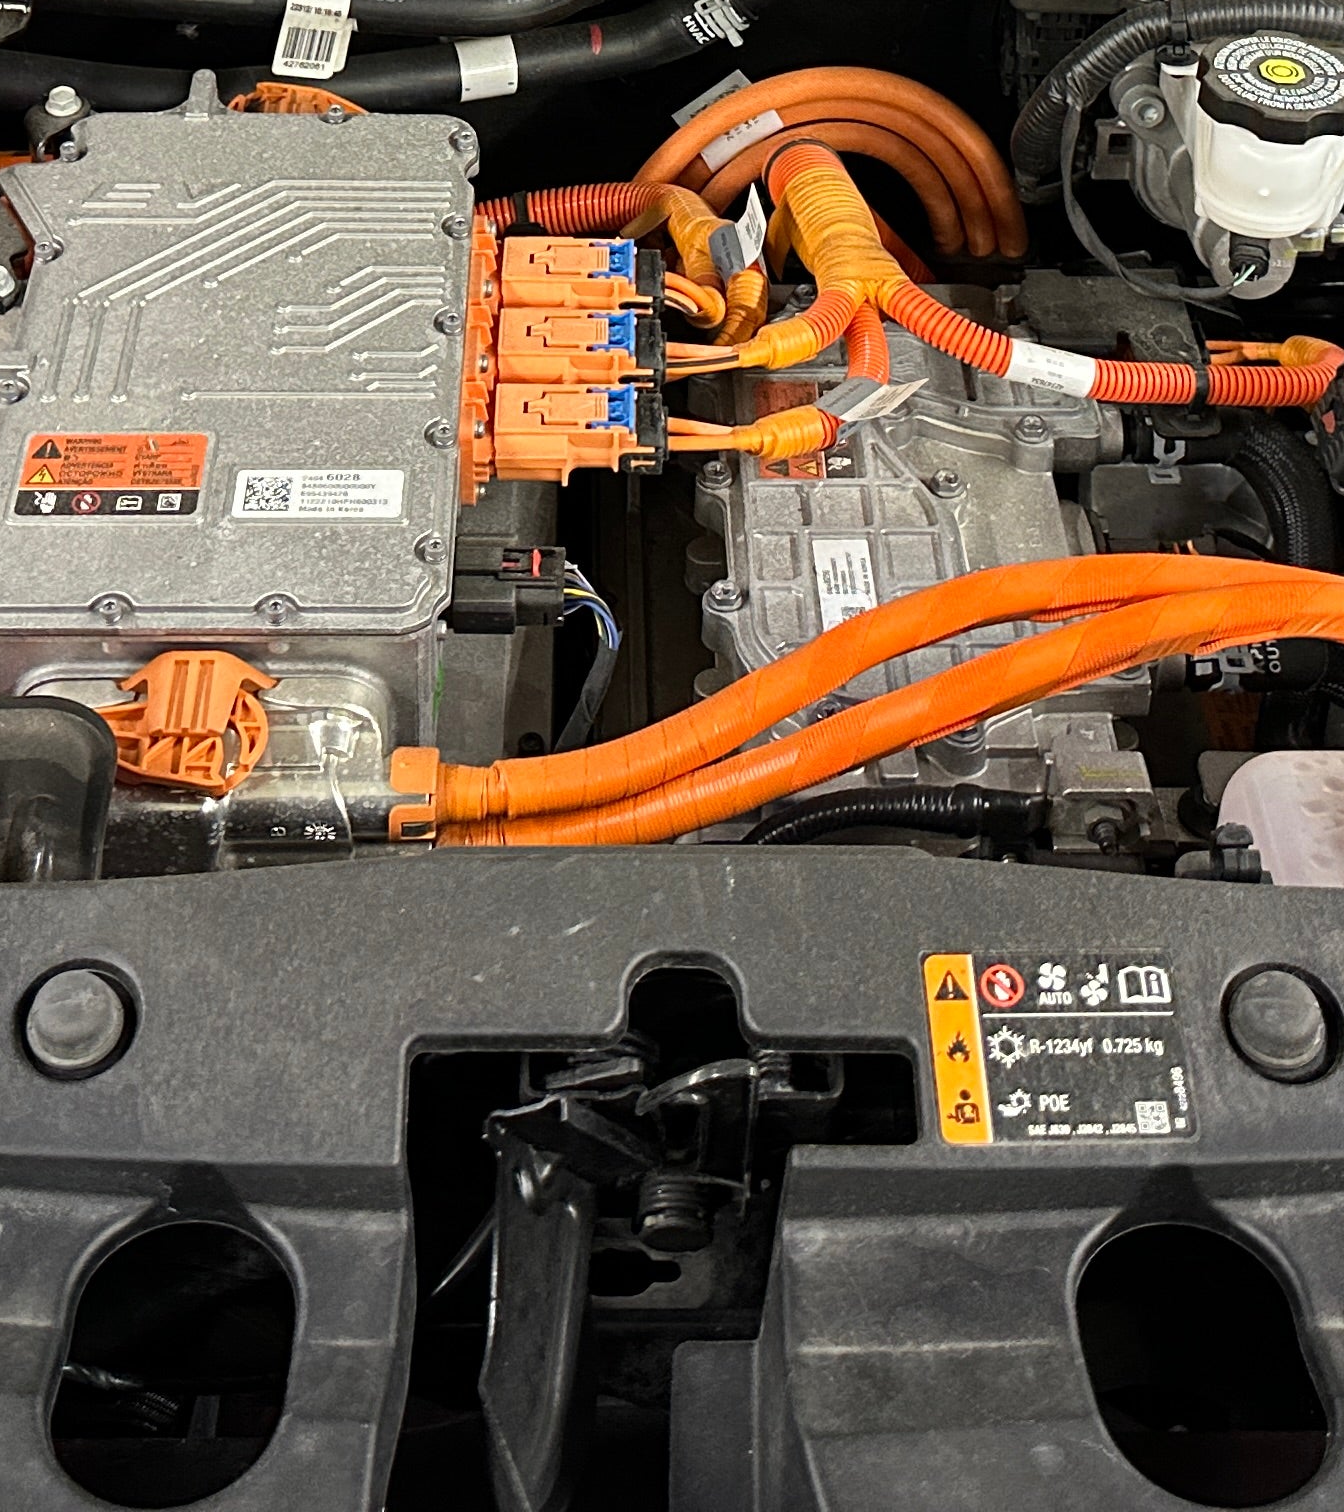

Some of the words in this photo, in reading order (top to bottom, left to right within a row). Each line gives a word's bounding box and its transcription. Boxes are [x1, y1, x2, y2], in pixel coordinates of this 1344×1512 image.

[682, 15, 710, 45] HVAC
[1234, 87, 1258, 101] FLUID
[1258, 97, 1284, 108] FROM
[1241, 82, 1273, 99] BEFORE
[1280, 86, 1308, 95] CLEAN
[1038, 993, 1073, 1006] AUTO
[1030, 1037, 1094, 1057] R-1234yf
[1102, 1037, 1143, 1054] 0.725
[1145, 1037, 1164, 1056] kg
[1038, 1094, 1071, 1112] POE
[1027, 1124, 1047, 1135] SAE
